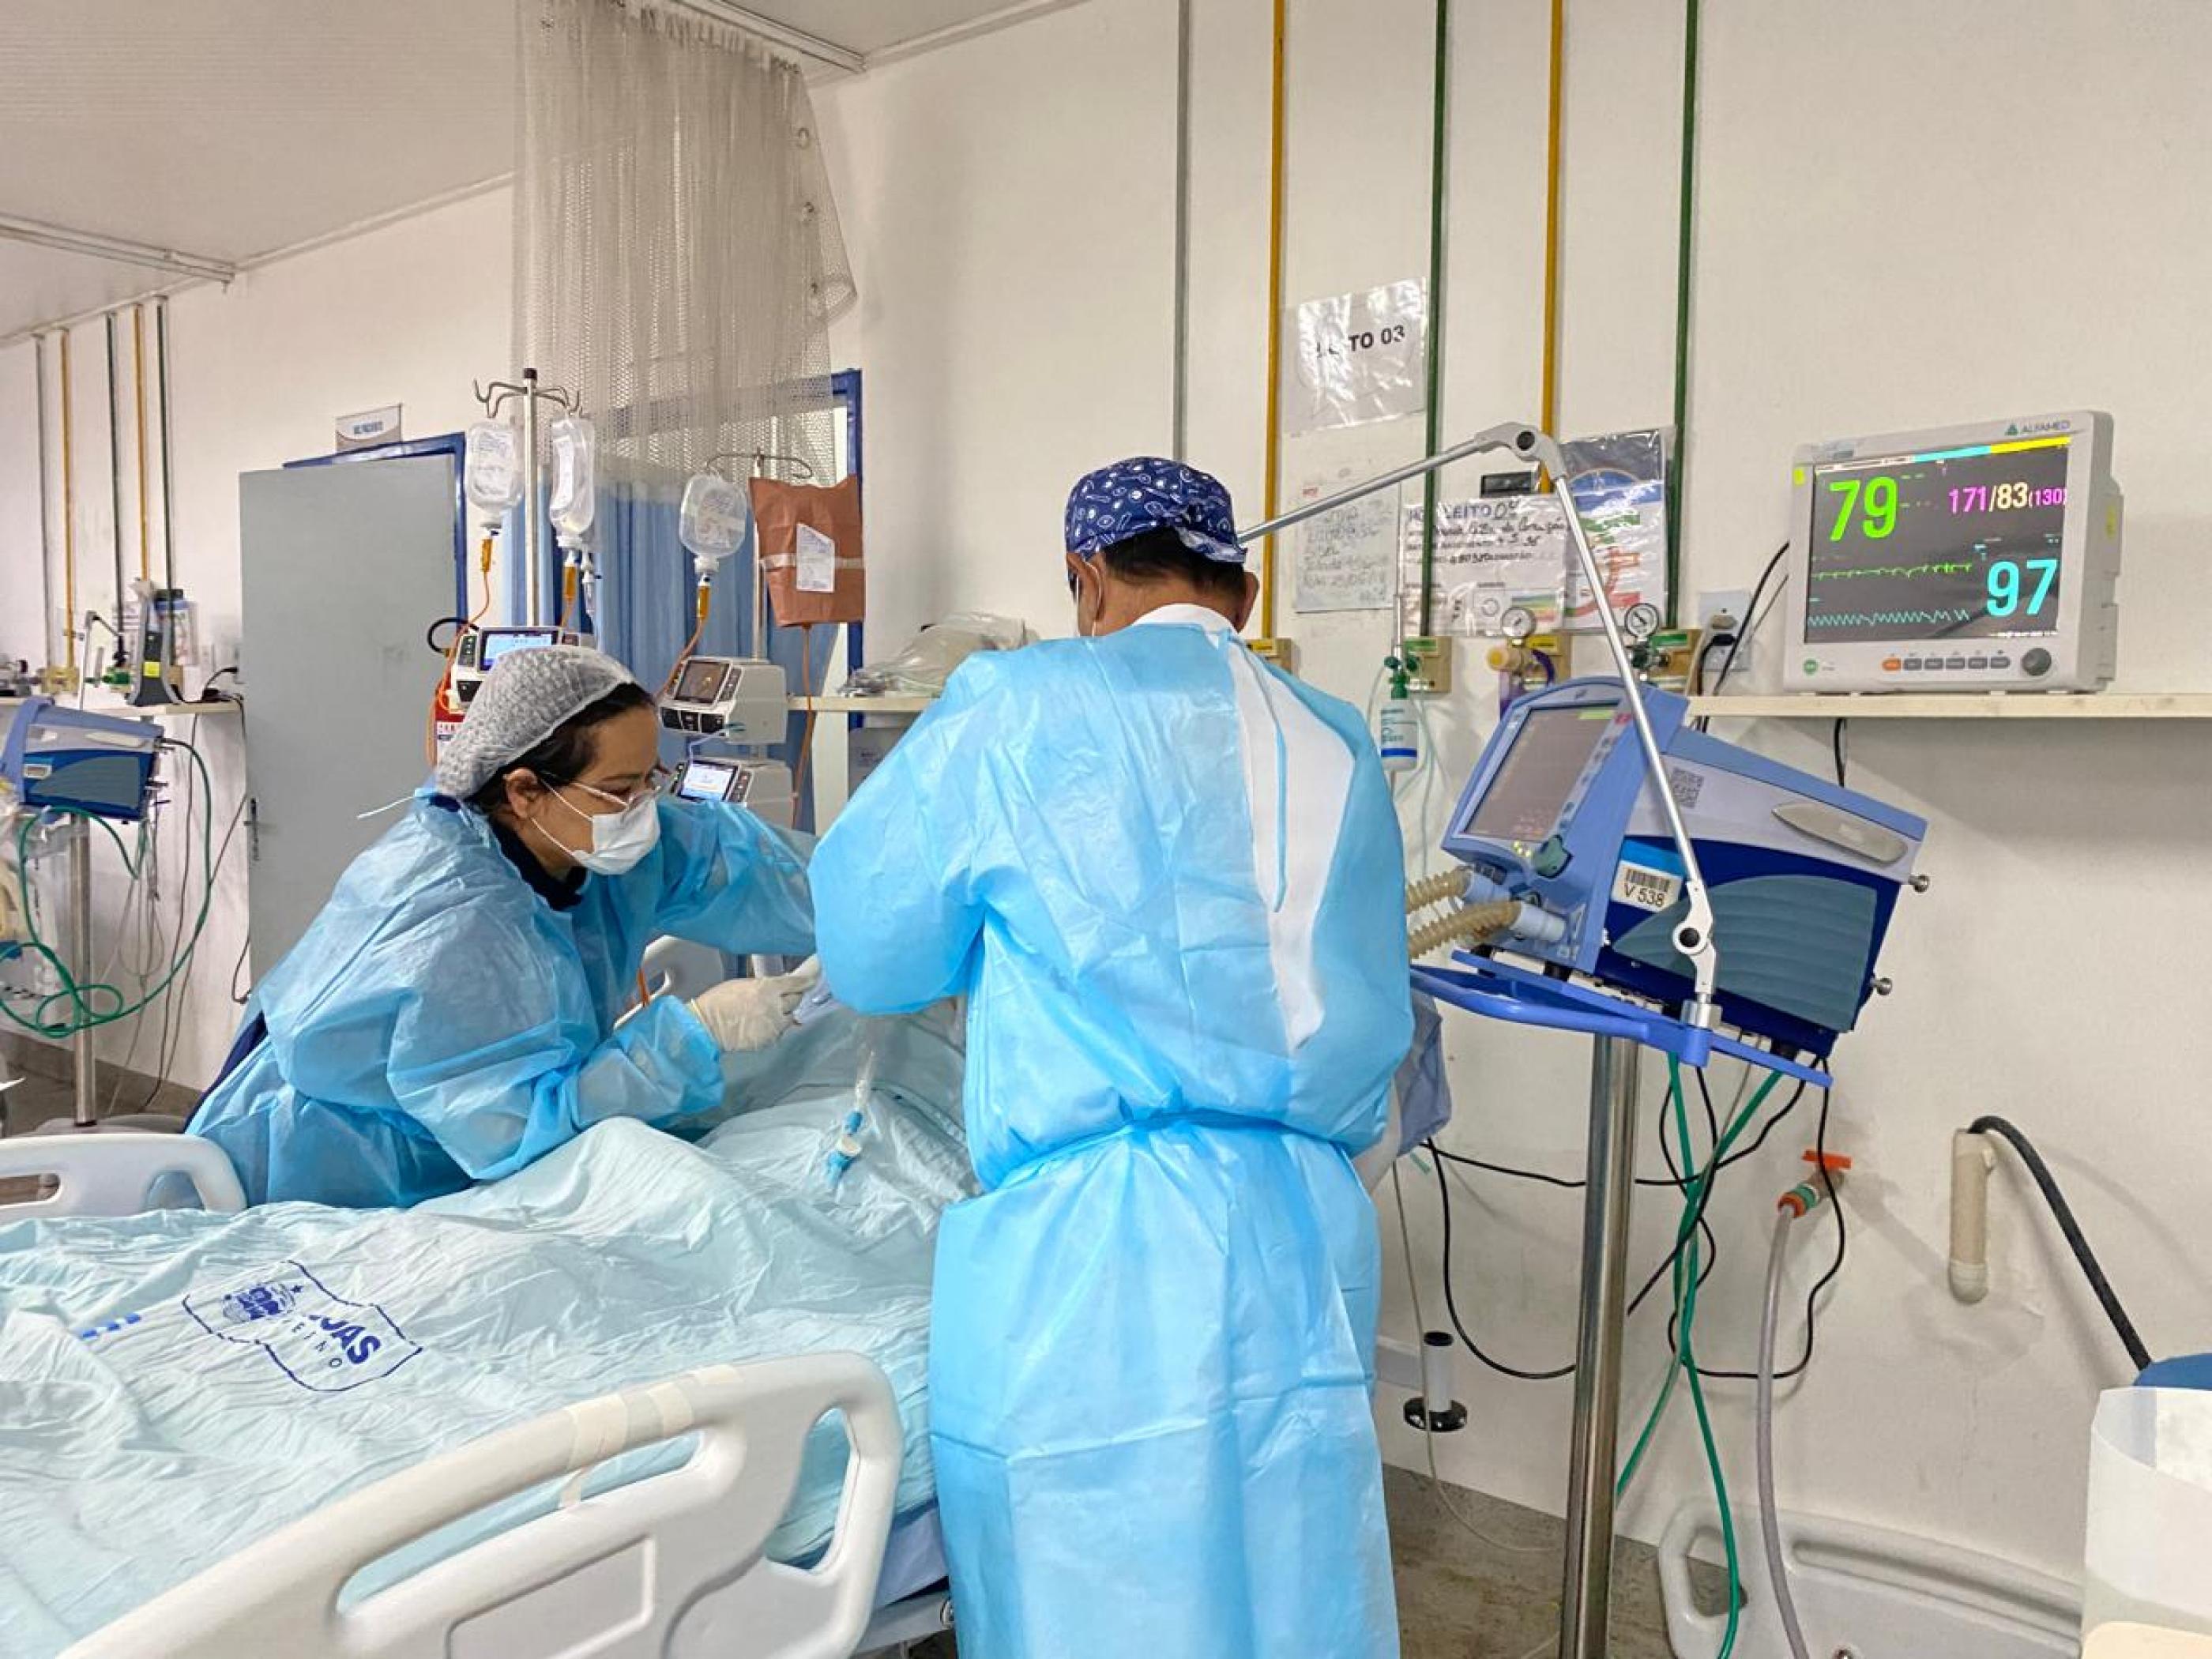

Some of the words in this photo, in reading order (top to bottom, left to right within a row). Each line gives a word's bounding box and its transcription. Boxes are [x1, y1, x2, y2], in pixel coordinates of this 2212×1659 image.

[1381, 324, 1405, 344] 03
[1828, 476, 1898, 542] 79
[1987, 558, 2058, 617] 97
[1624, 882, 1635, 897] V
